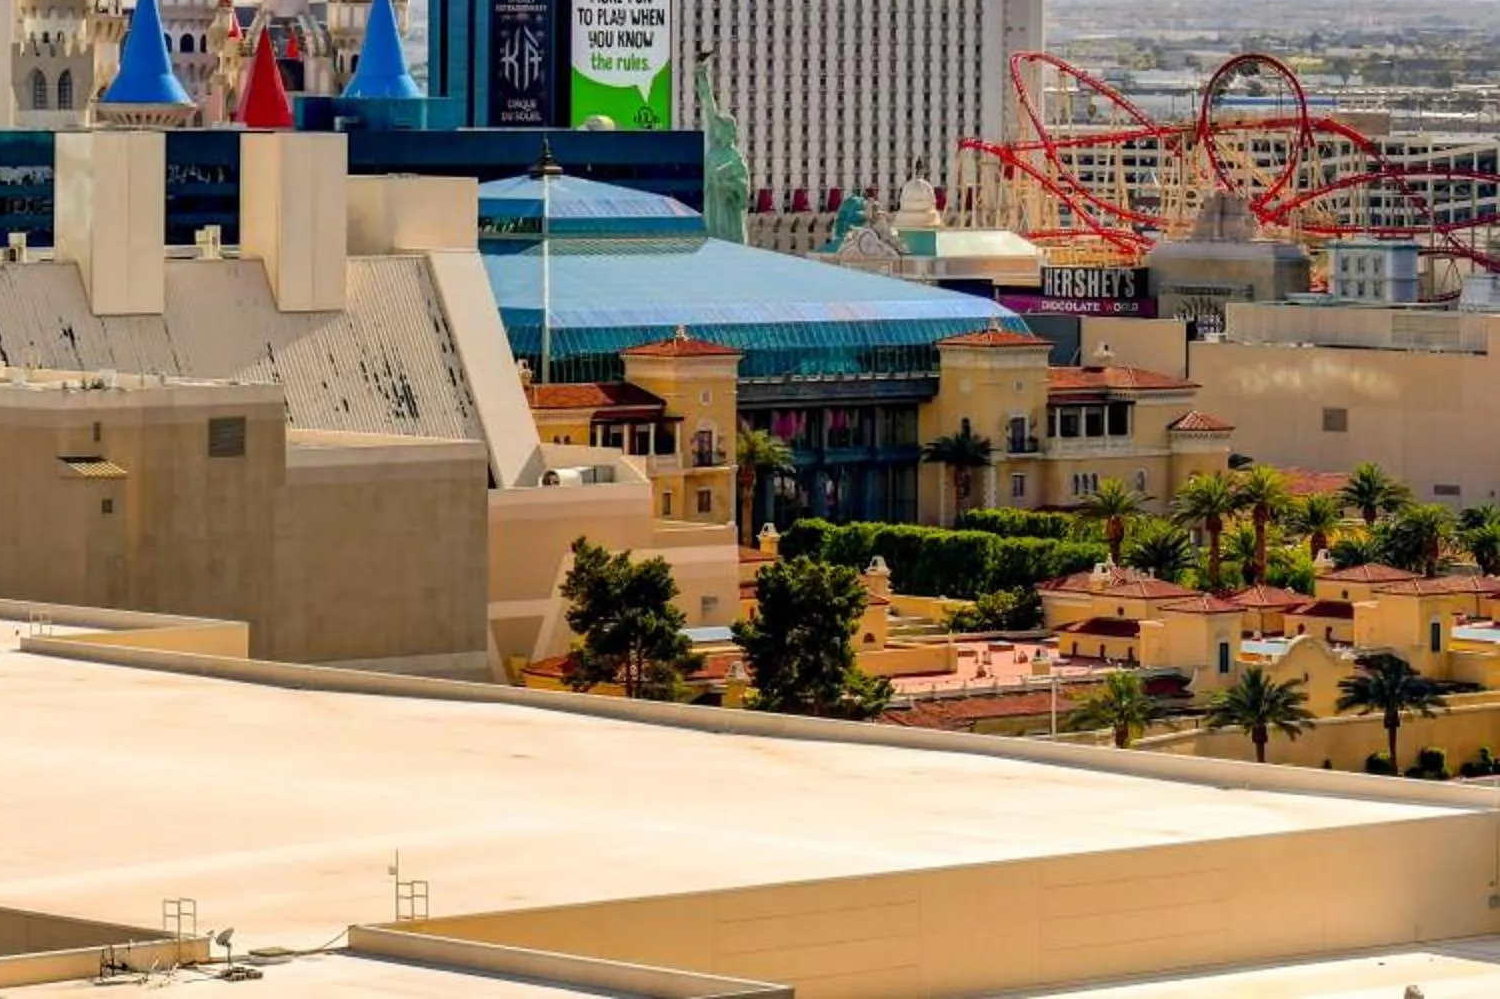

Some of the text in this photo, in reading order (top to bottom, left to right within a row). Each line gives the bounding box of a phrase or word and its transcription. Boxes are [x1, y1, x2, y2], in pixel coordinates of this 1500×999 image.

[577, 7, 665, 26] TO PLAY WHEN
[588, 31, 655, 48] YOU KNOW
[591, 52, 613, 70] the
[1043, 268, 1136, 298] HERSHEY'S
